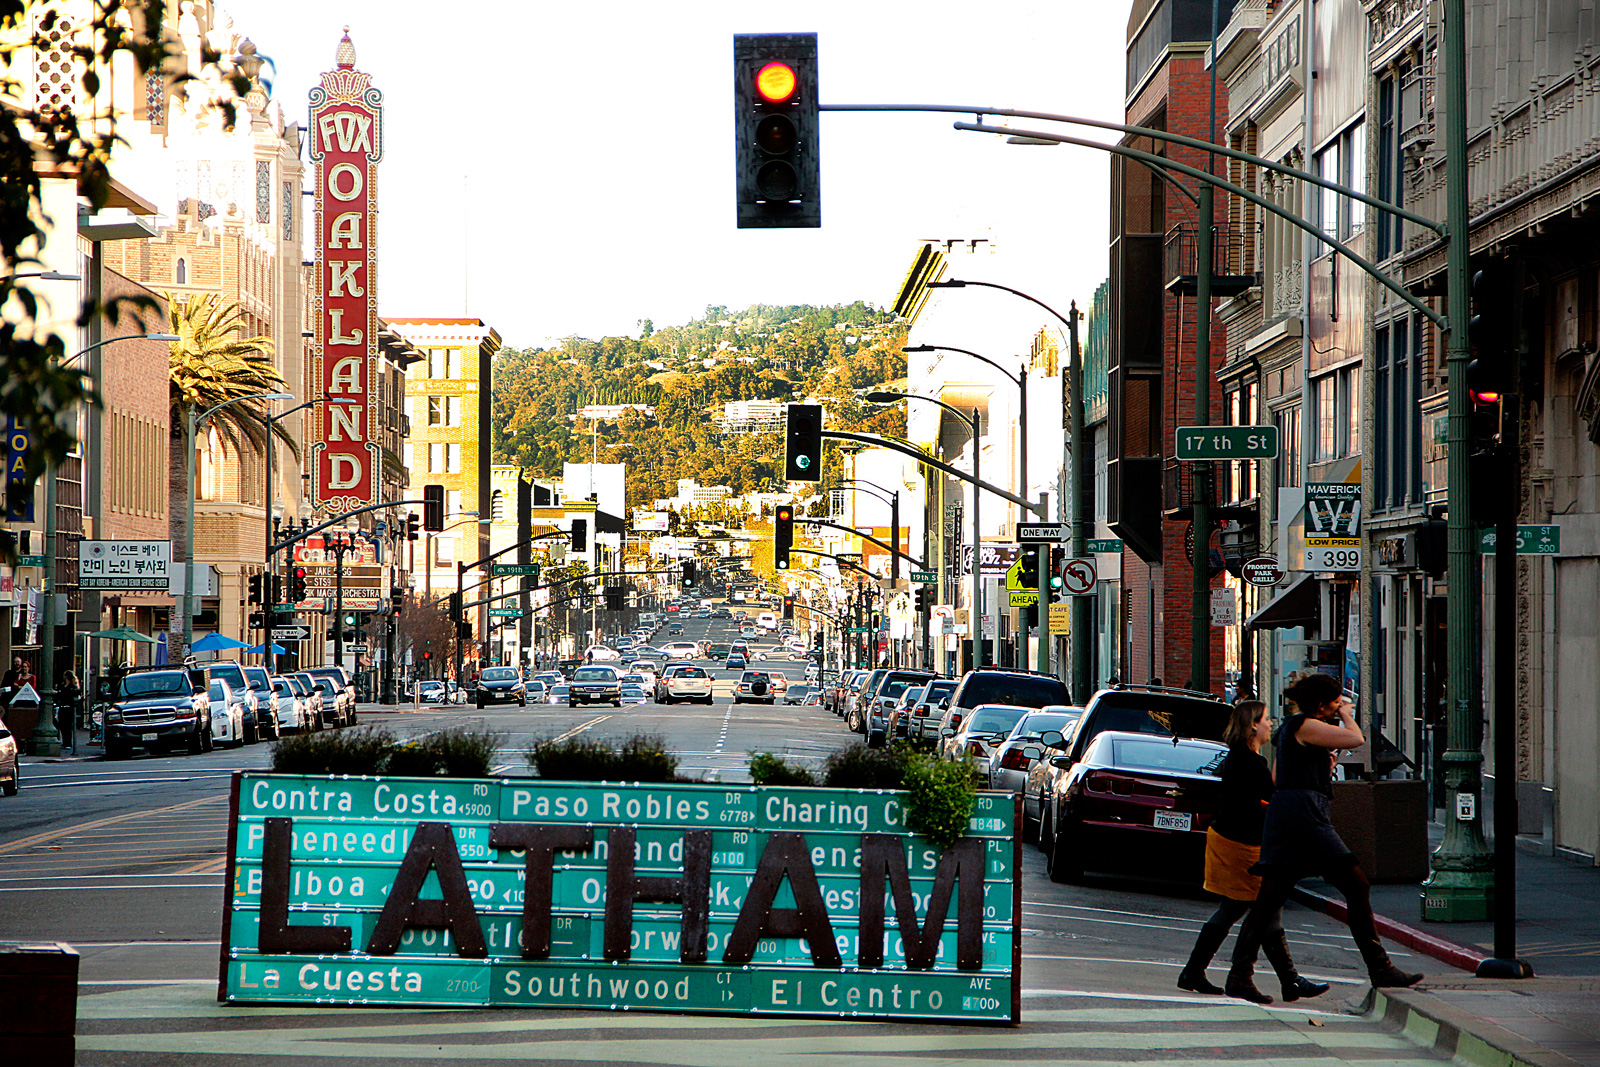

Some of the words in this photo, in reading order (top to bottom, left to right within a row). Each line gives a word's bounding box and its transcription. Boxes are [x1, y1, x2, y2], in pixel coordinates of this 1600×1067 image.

[318, 112, 373, 153] FOX
[328, 161, 365, 490] OAKLAND
[1247, 435, 1267, 449] St
[1307, 485, 1361, 494] MAVERICK
[1022, 529, 1040, 537] ONE
[1540, 526, 1551, 535] ST
[111, 545, 139, 556] 이스트
[142, 545, 160, 556] 베이
[1538, 544, 1556, 553] 500
[1307, 551, 1313, 561] $
[83, 559, 104, 574] 한미
[109, 559, 130, 574] 노인
[134, 559, 166, 575] 봉사회
[912, 573, 929, 581] 19th
[1011, 595, 1038, 604] AHEAD
[1212, 589, 1223, 599] NO
[1212, 600, 1234, 608] PARKING
[252, 780, 353, 812] Contra
[374, 784, 458, 815] Costa
[473, 784, 489, 797] RD
[465, 803, 492, 816] 5900
[512, 790, 589, 818] Paso
[602, 792, 710, 821] Robles
[725, 792, 742, 805] DR
[719, 809, 749, 823] 6778
[766, 796, 869, 831] Charing
[977, 797, 993, 810] RD
[1156, 815, 1189, 829] 7BNF850
[459, 827, 476, 840] DR
[733, 831, 748, 844] RD
[988, 840, 1003, 852] PL
[711, 852, 745, 865] 6100
[247, 869, 365, 896] Blboa
[258, 816, 985, 973] LATHAM
[322, 913, 339, 926] ST
[556, 917, 573, 929] DR
[239, 962, 281, 988] La
[298, 963, 423, 993] Cuesta
[446, 979, 478, 992] 2700
[503, 970, 690, 1001] Southwood
[716, 972, 732, 984] CT
[771, 979, 803, 1005] El
[820, 980, 944, 1010] Centro
[969, 977, 992, 990] AVE
[963, 996, 995, 1011] 4700
